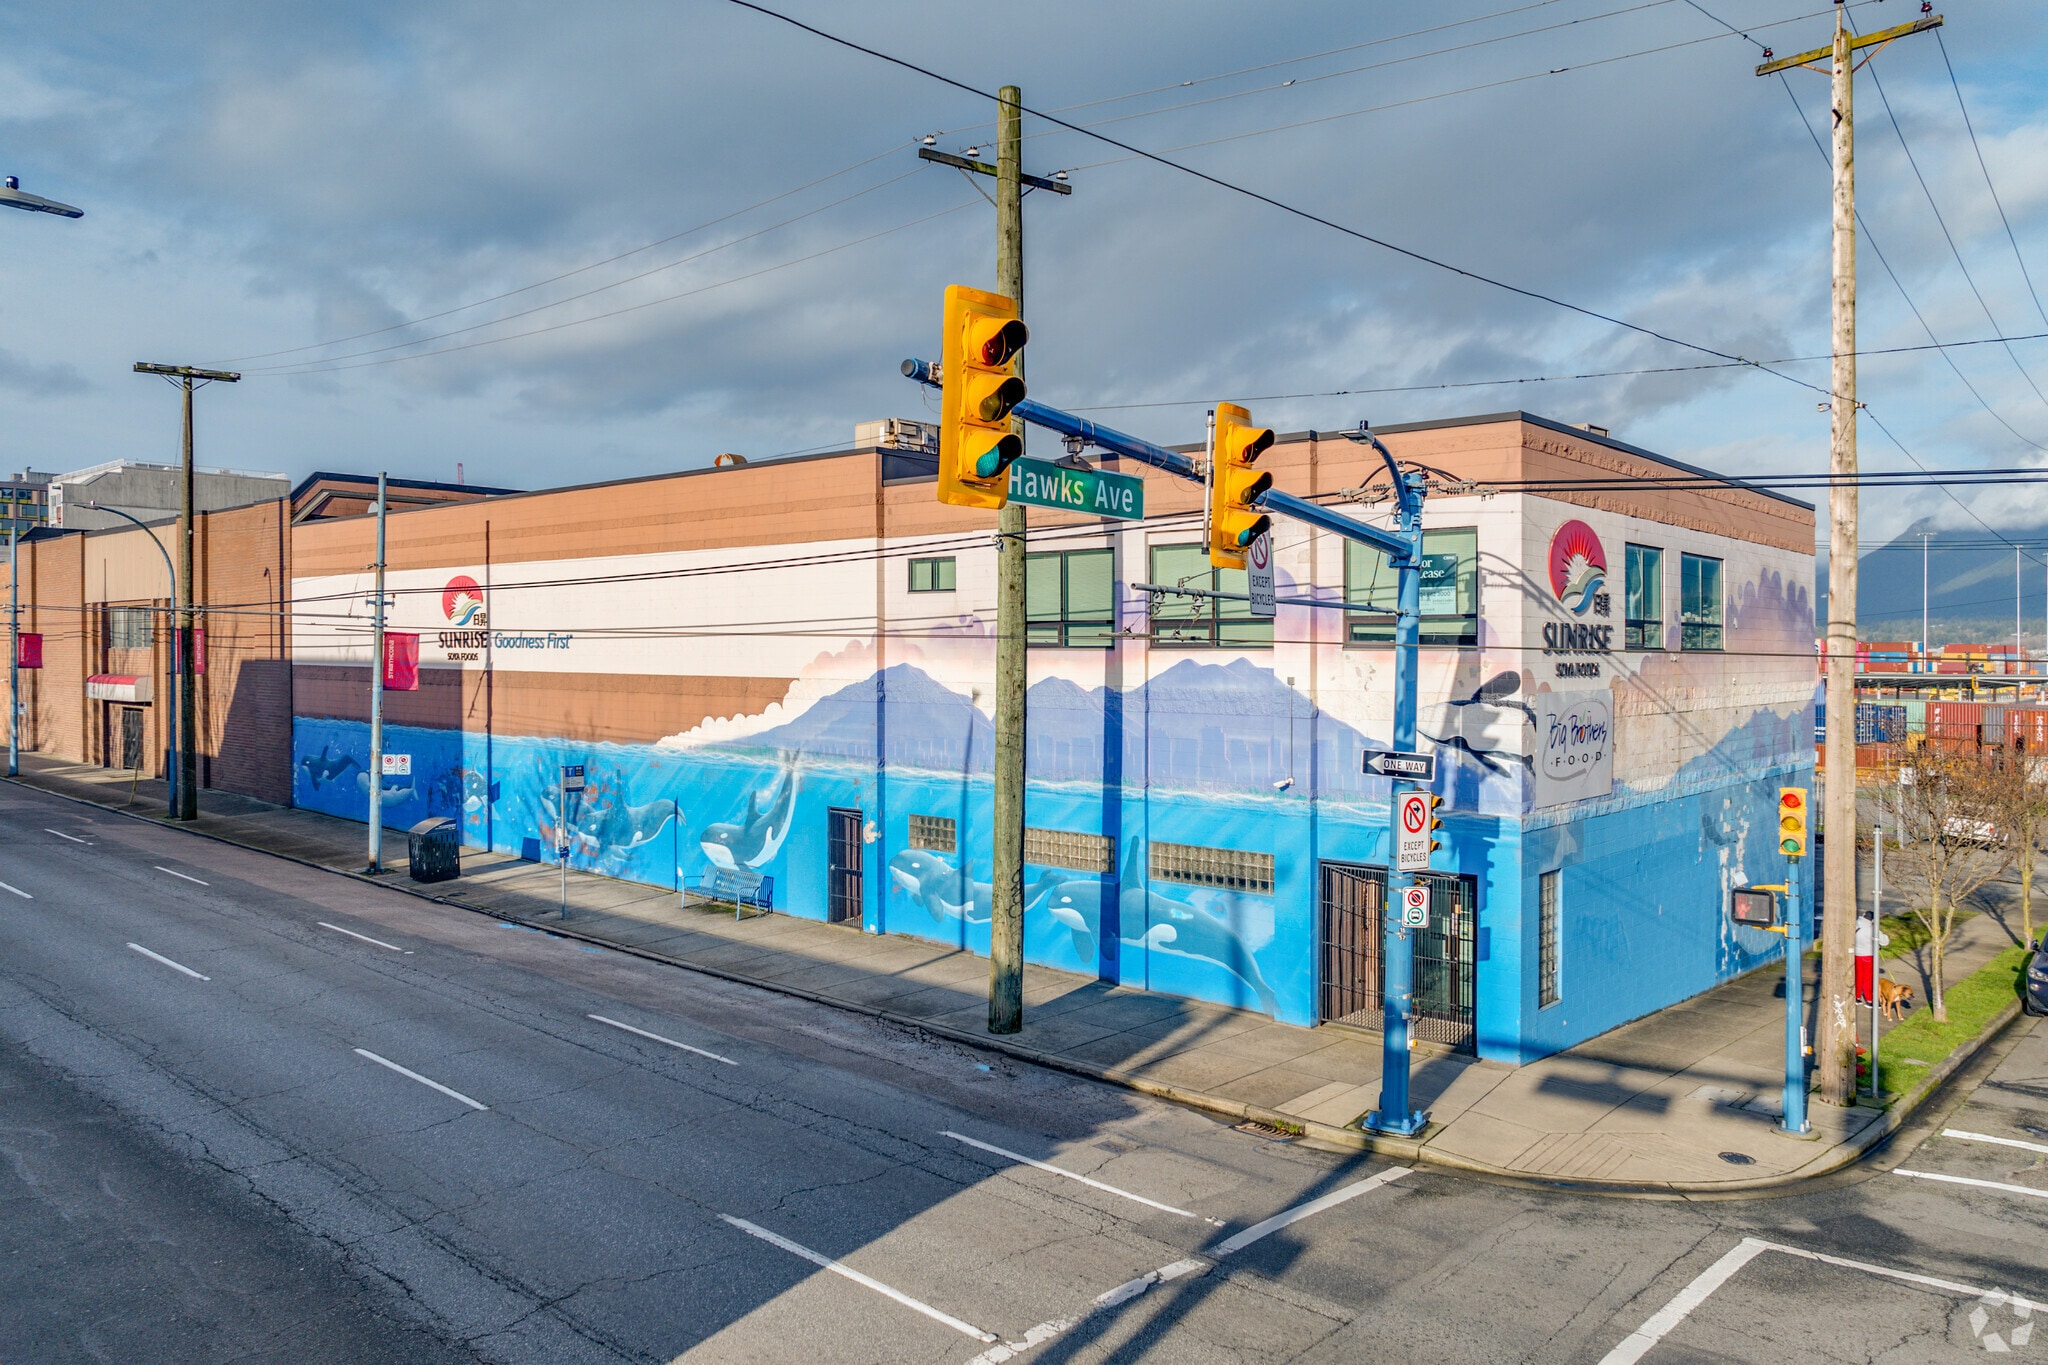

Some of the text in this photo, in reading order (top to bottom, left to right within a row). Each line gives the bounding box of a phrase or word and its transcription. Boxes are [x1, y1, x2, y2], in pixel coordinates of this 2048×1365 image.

[1008, 464, 1133, 512] Hawks Ave
[1252, 575, 1271, 588] EXCEPT
[1251, 592, 1274, 606] BICYCLES
[438, 631, 489, 648] SUNRISE
[494, 632, 545, 649] Goodness
[1542, 622, 1614, 656] SUNRISE
[461, 652, 479, 661] FOODS
[1546, 710, 1607, 754] Big Brothers
[1383, 759, 1425, 772] ONE WAY
[1404, 840, 1424, 851] EXCEPT
[1401, 852, 1426, 863] BICYCLES
